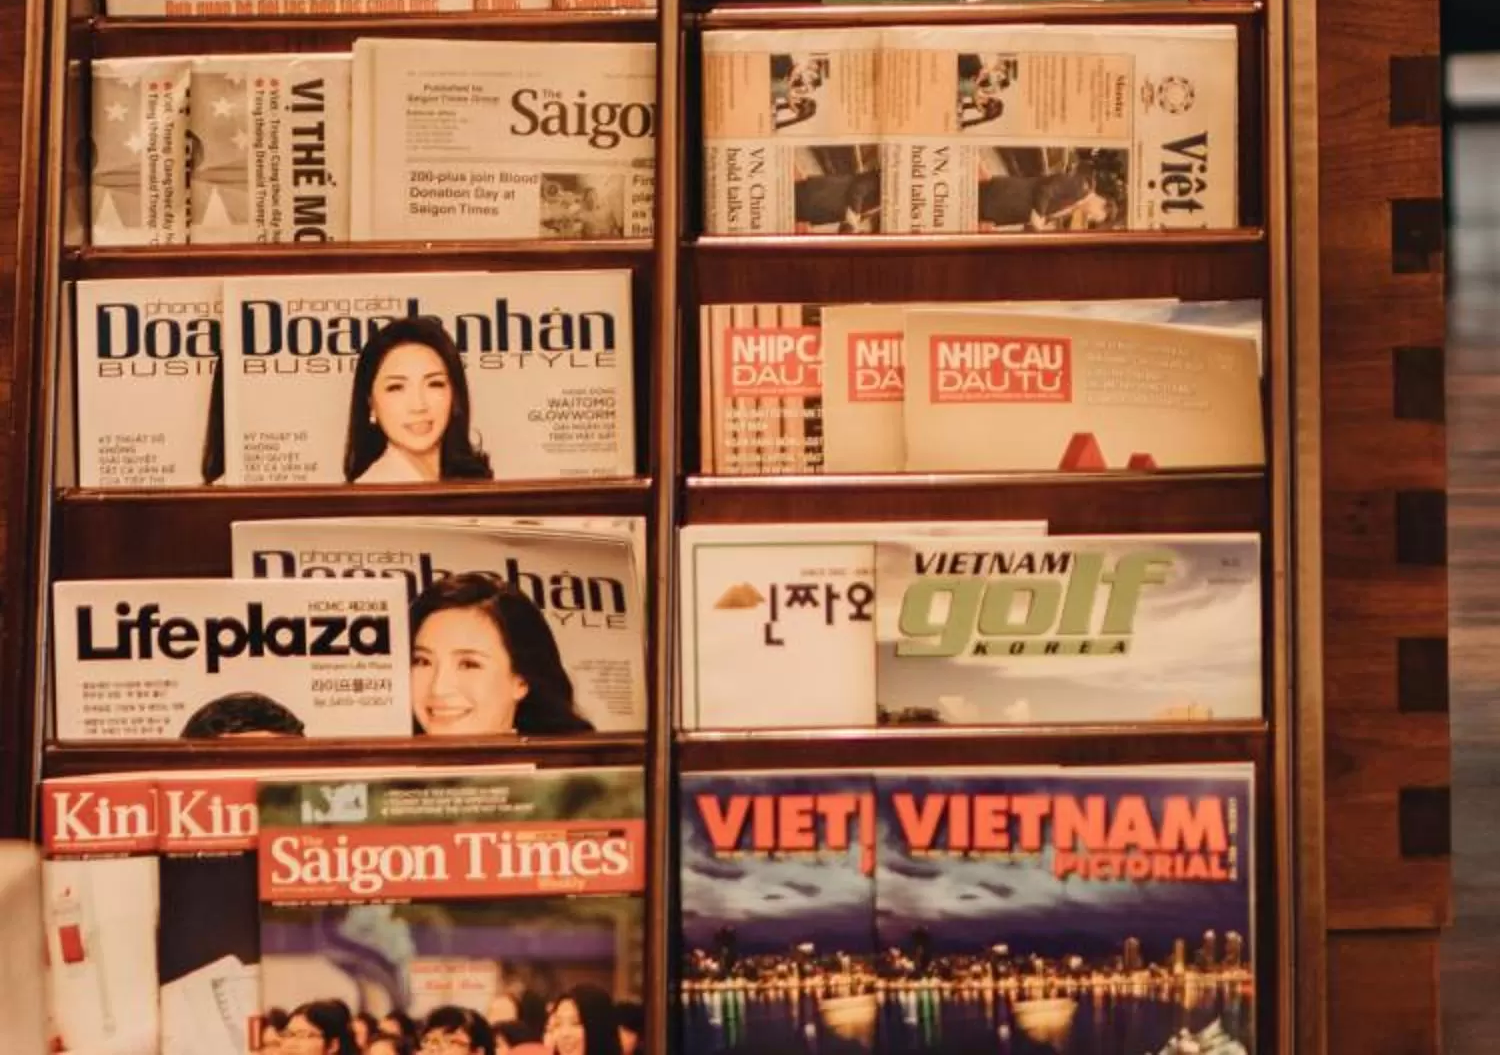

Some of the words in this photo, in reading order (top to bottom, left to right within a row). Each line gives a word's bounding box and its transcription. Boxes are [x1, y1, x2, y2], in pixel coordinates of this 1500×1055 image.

[284, 78, 325, 113] VỊ
[542, 88, 562, 99] The
[510, 88, 656, 149] Saigo
[409, 170, 467, 186] 200-plus
[469, 170, 495, 185] join
[1148, 131, 1209, 215] Việt
[409, 186, 471, 199] Donation
[473, 187, 500, 202] Day
[503, 188, 516, 200] at
[409, 202, 457, 217] Saigon
[459, 203, 499, 216] Times
[287, 297, 351, 317] phong
[478, 352, 618, 370] STYLE
[913, 551, 1071, 576] VIETNAM
[895, 550, 1180, 658] golf
[76, 601, 392, 674] Lifeplaza
[972, 639, 1128, 656] KOREA
[51, 788, 159, 842] Kin
[892, 793, 1229, 854] VIETNAM
[270, 834, 450, 895] Saigon
[453, 830, 632, 881] Times
[1052, 850, 1230, 883] PICTORIAL
